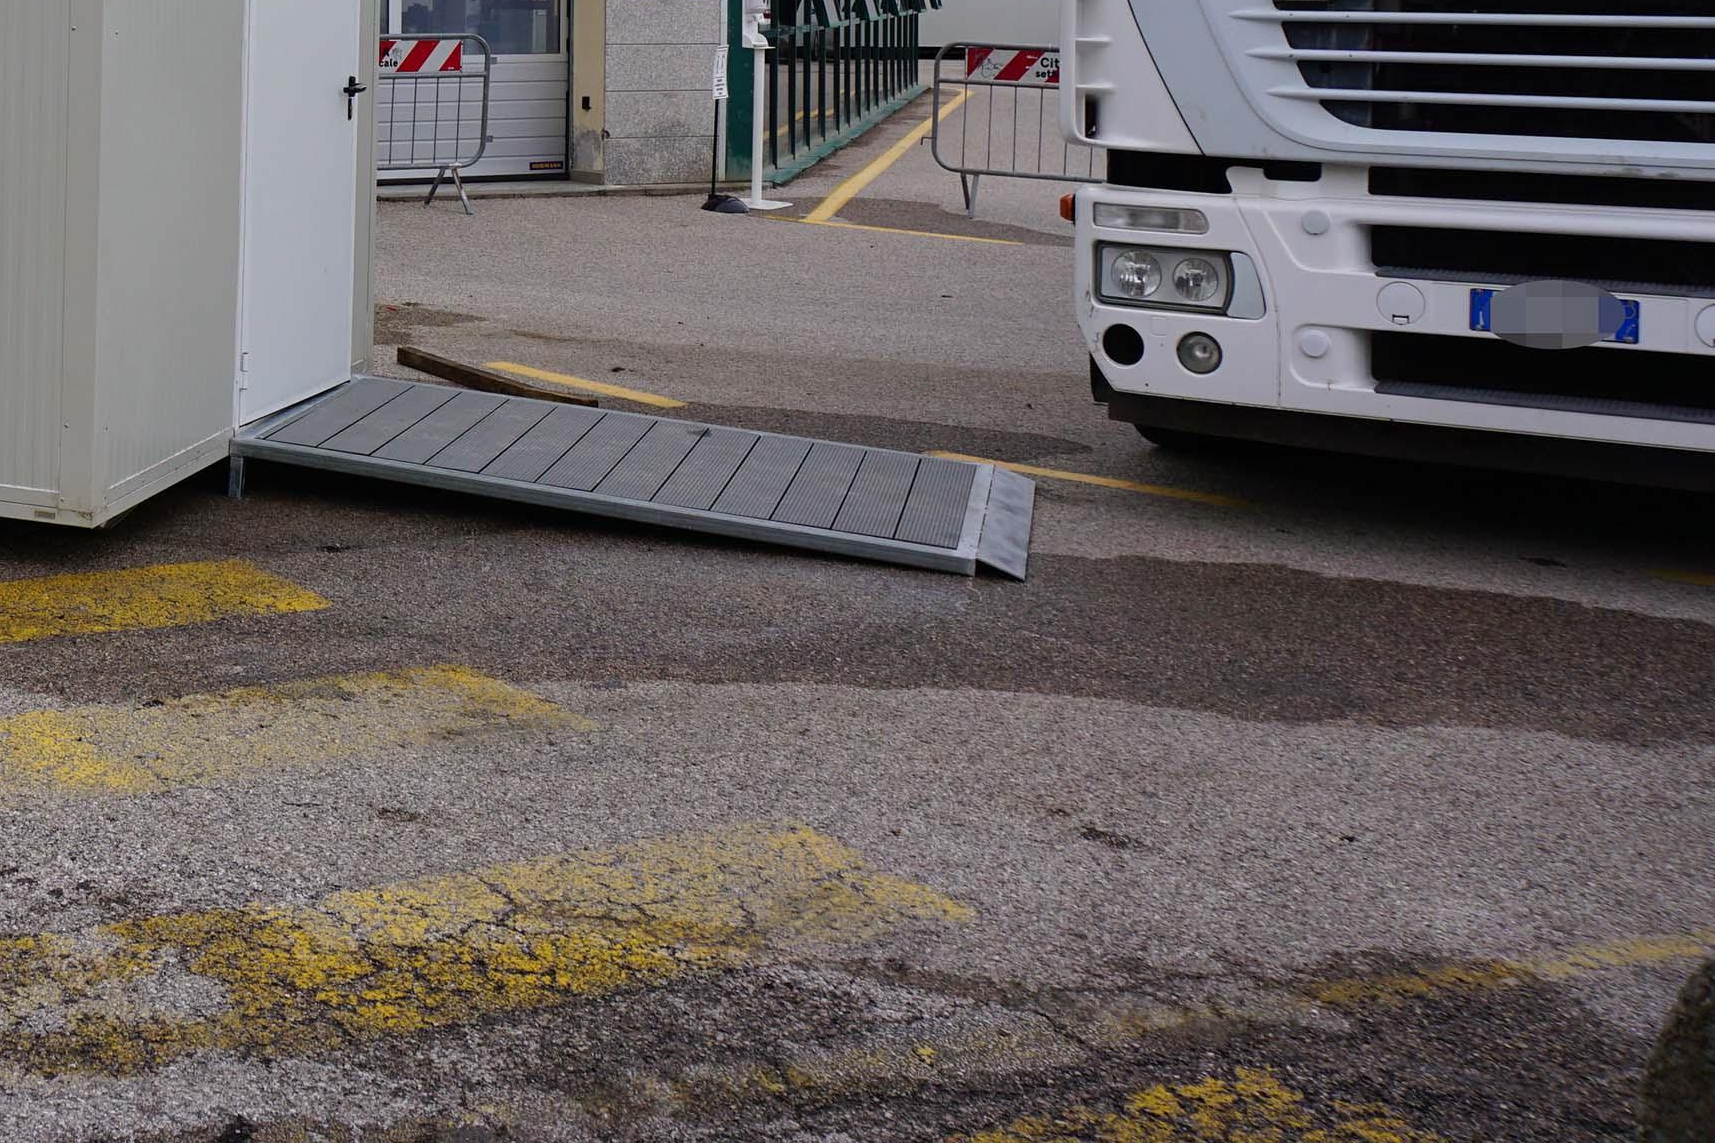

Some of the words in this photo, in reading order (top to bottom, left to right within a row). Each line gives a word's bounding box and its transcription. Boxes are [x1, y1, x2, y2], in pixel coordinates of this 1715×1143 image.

[379, 58, 398, 67] cale
[1040, 57, 1060, 69] Cit
[1035, 69, 1055, 78] sett
